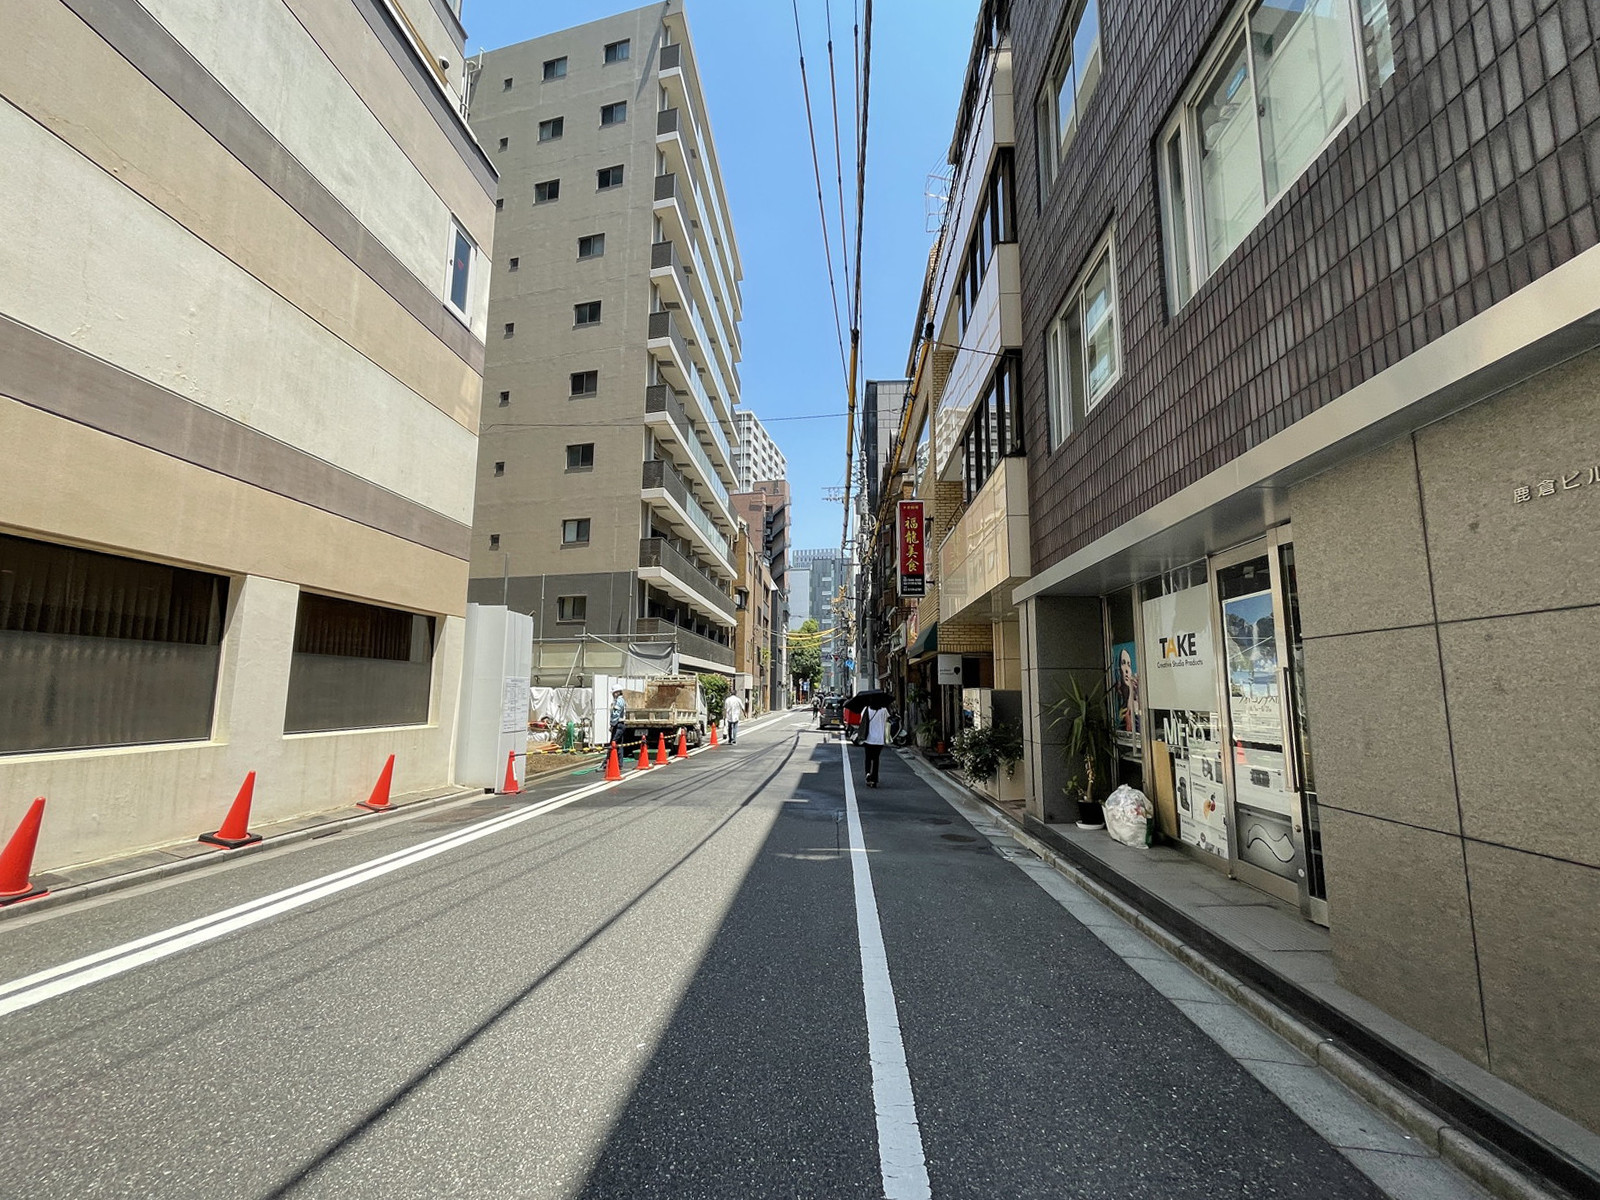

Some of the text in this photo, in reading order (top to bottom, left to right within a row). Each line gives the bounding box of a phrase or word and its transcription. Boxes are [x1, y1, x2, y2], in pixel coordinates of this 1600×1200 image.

[1159, 633, 1197, 659] TAKE
[1157, 658, 1203, 669] Creative Studio Products
